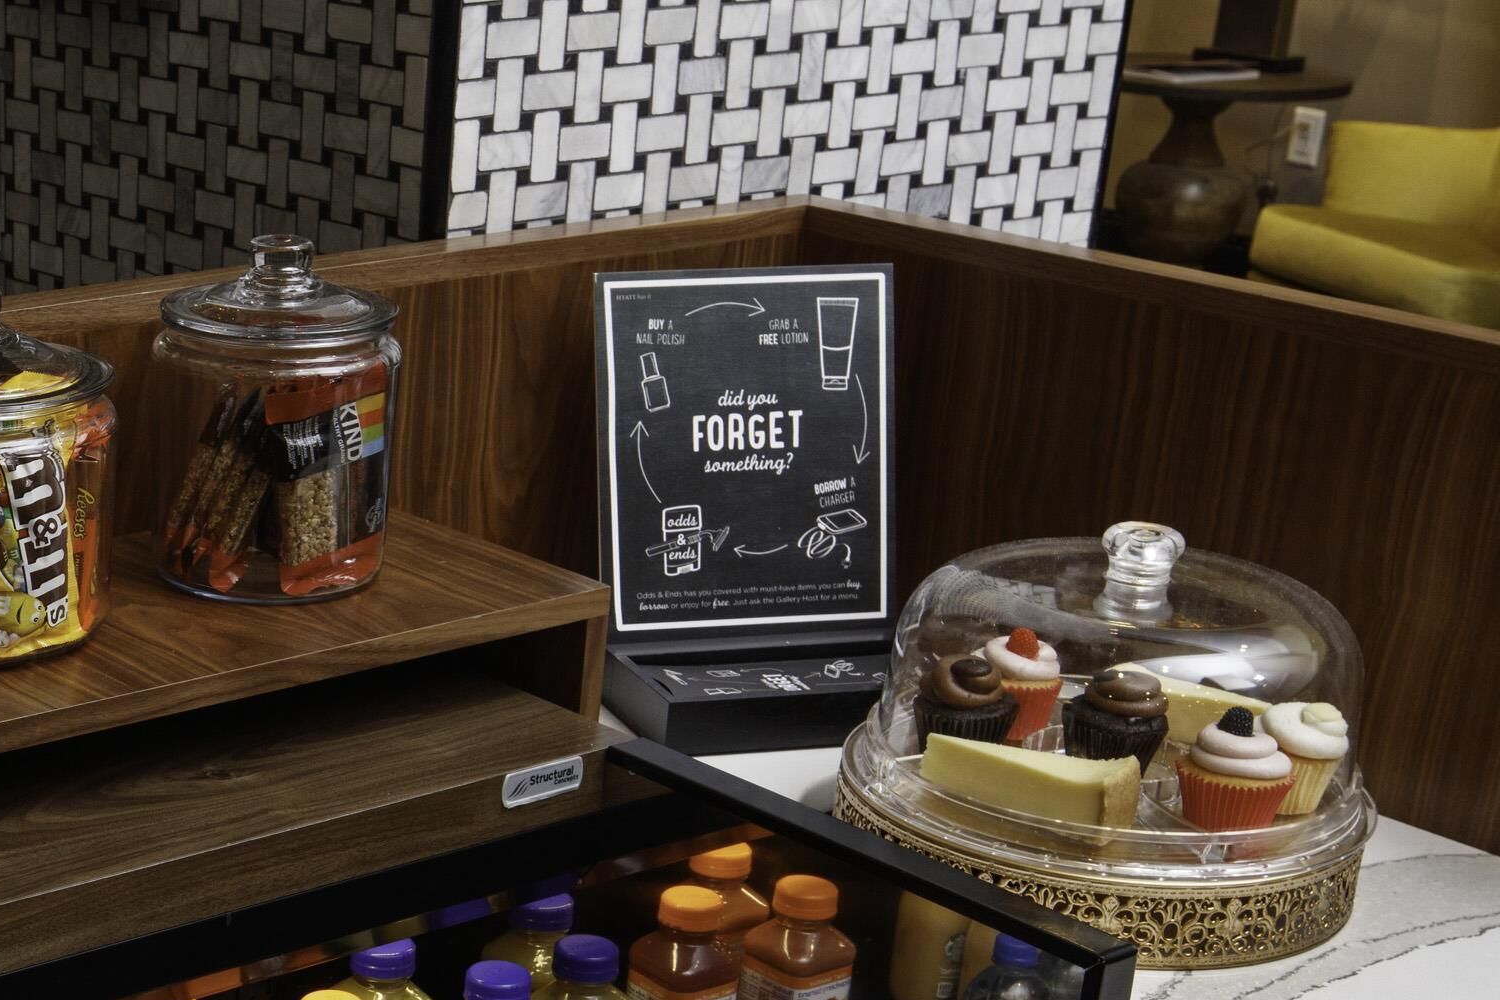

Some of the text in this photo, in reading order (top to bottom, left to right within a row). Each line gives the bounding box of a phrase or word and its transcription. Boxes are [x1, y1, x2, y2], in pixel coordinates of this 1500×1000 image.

[648, 319, 673, 330] BUY A
[769, 318, 798, 330] GRAB A
[636, 333, 685, 345] NAIL POLISH
[759, 332, 809, 345] FREE LOTION
[718, 389, 779, 411] did you
[340, 402, 362, 461] KIND
[692, 409, 804, 453] FORGET
[704, 452, 794, 476] something?
[814, 476, 856, 495] BORROW A
[819, 491, 855, 508] CHARGER
[667, 513, 698, 528] odds
[676, 533, 687, 546] &
[668, 547, 697, 560] ends
[636, 592, 656, 600] Odds
[664, 590, 682, 598] Ends
[698, 590, 712, 598] you
[713, 587, 742, 595] covered
[760, 584, 796, 592] must-have
[818, 583, 831, 591] you
[639, 602, 669, 611] borrow
[680, 602, 699, 610] enjoy
[701, 600, 711, 608] for
[530, 765, 574, 786] Structural
